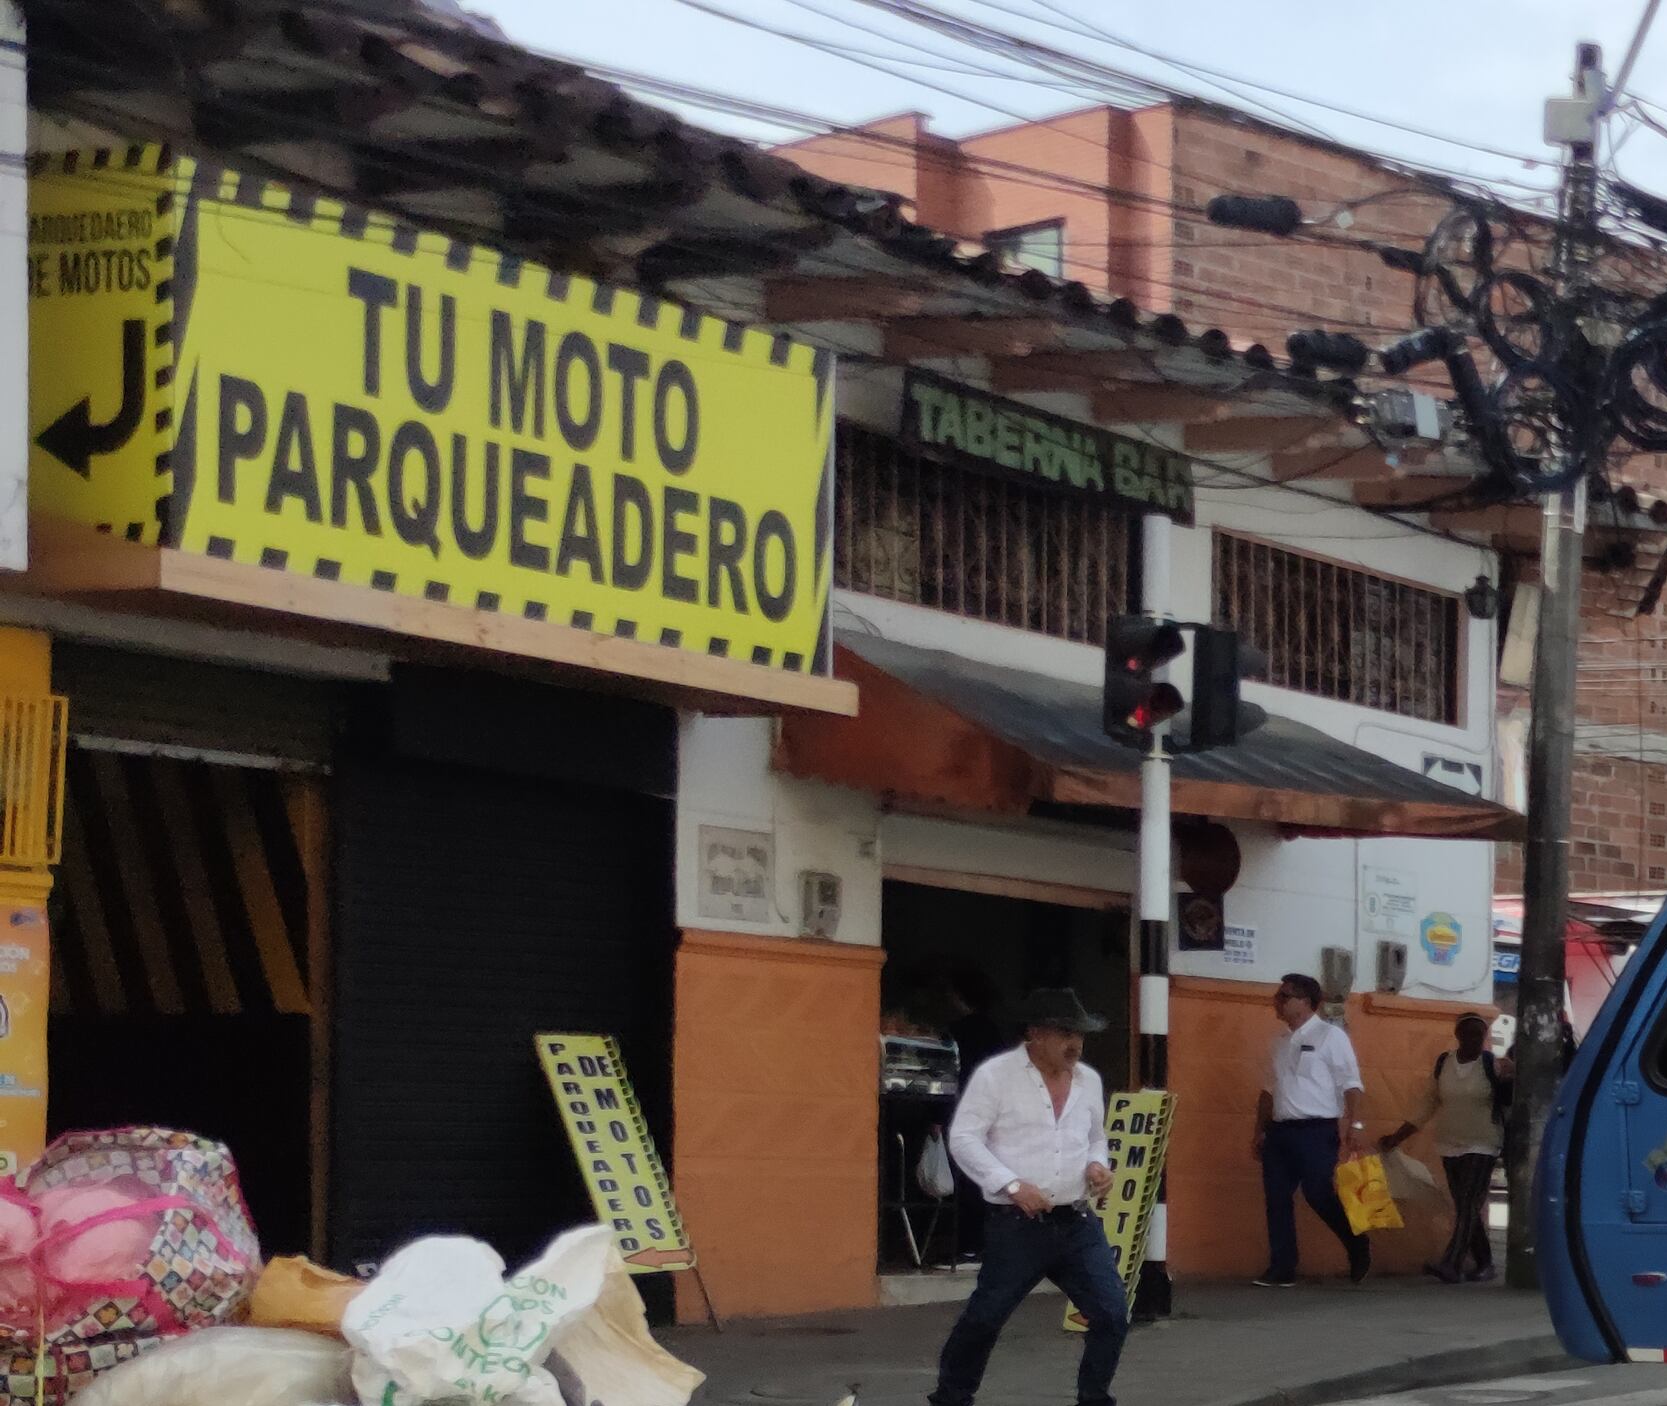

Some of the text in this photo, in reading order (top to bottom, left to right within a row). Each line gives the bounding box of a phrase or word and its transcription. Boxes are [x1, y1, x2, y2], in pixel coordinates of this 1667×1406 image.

[60, 249, 150, 296] MOTOS
[348, 266, 701, 476] TU MOTO
[217, 373, 798, 623] PARQUEADERO
[911, 382, 1194, 508] TABERNA BAR
[577, 1056, 613, 1077] DE
[1129, 1112, 1157, 1135] DE
[548, 1043, 639, 1250] PARQUEADERO
[593, 1088, 666, 1240] MOTOS
